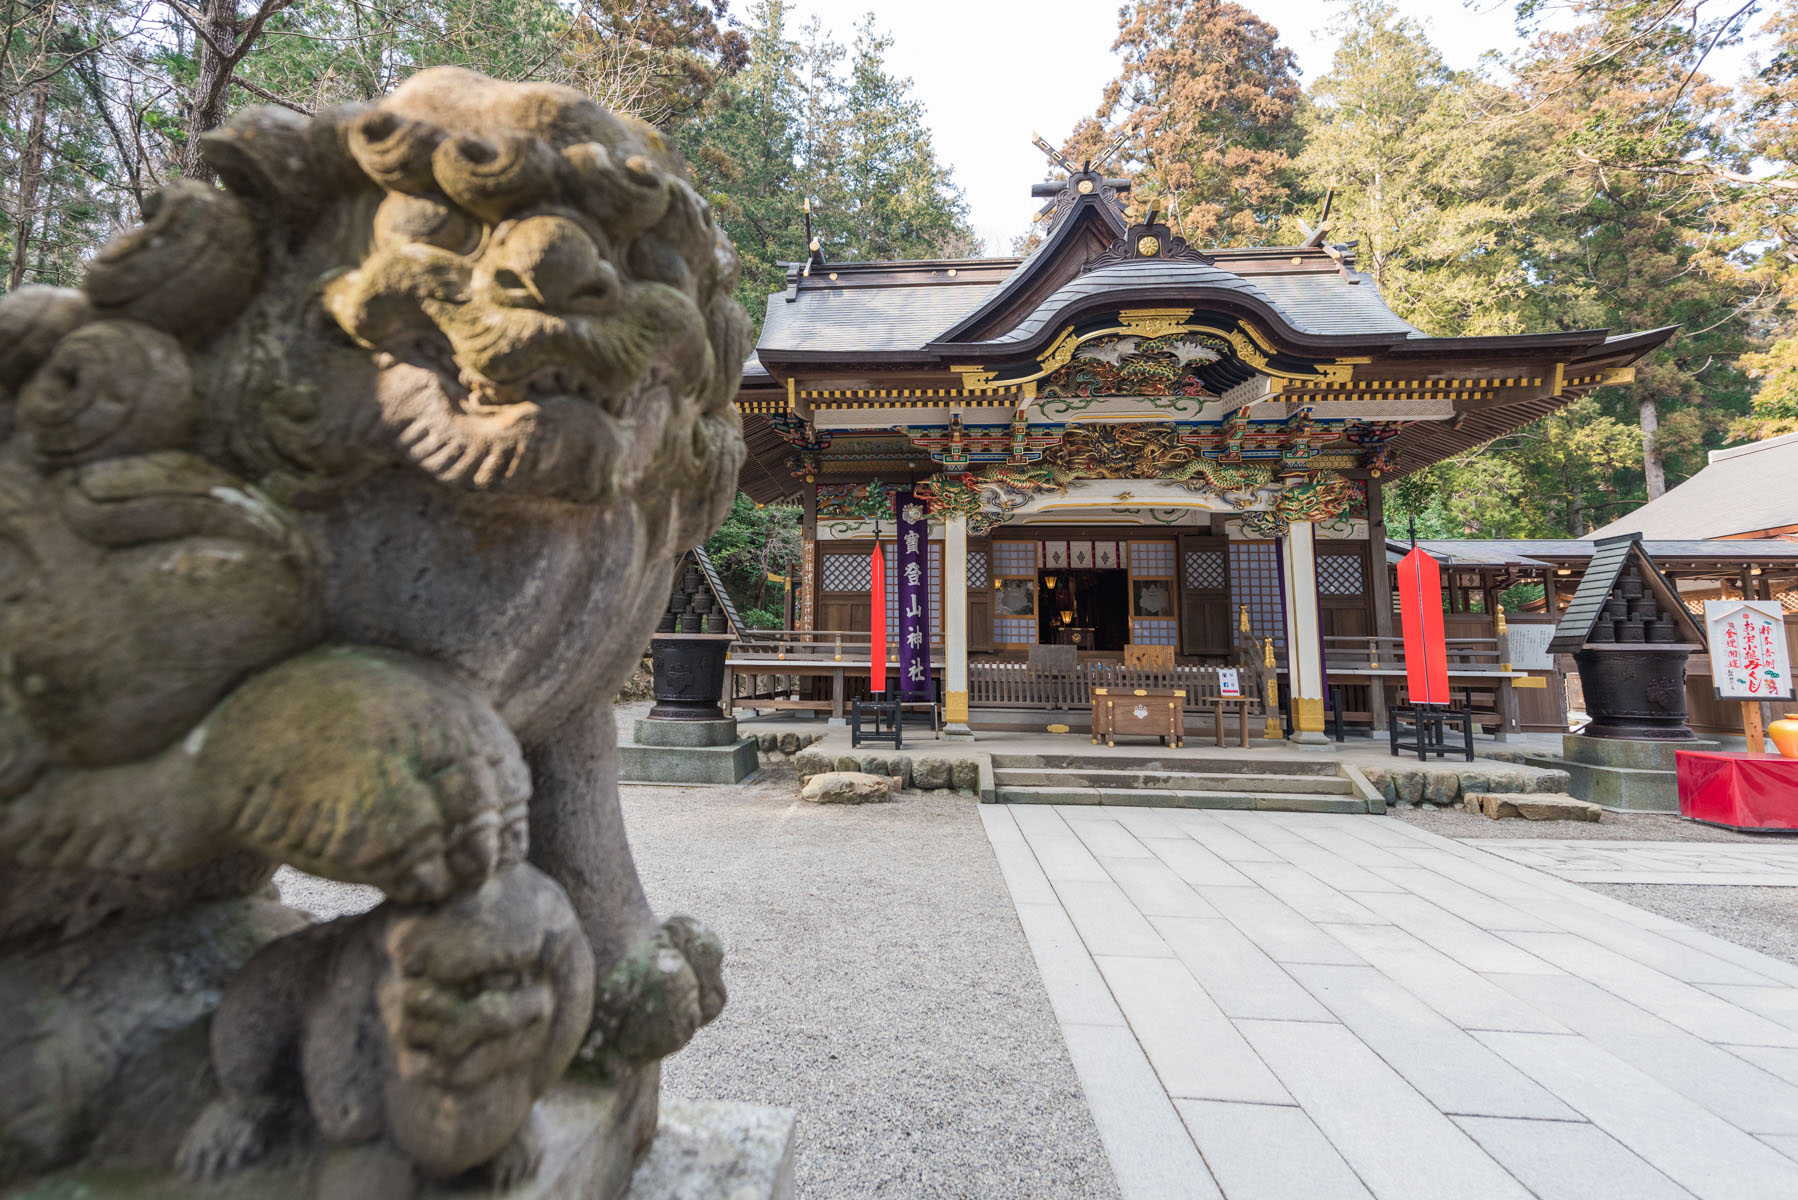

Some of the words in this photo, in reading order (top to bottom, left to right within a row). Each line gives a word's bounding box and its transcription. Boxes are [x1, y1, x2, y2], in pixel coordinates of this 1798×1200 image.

[904, 530, 925, 682] 寶登山神社
